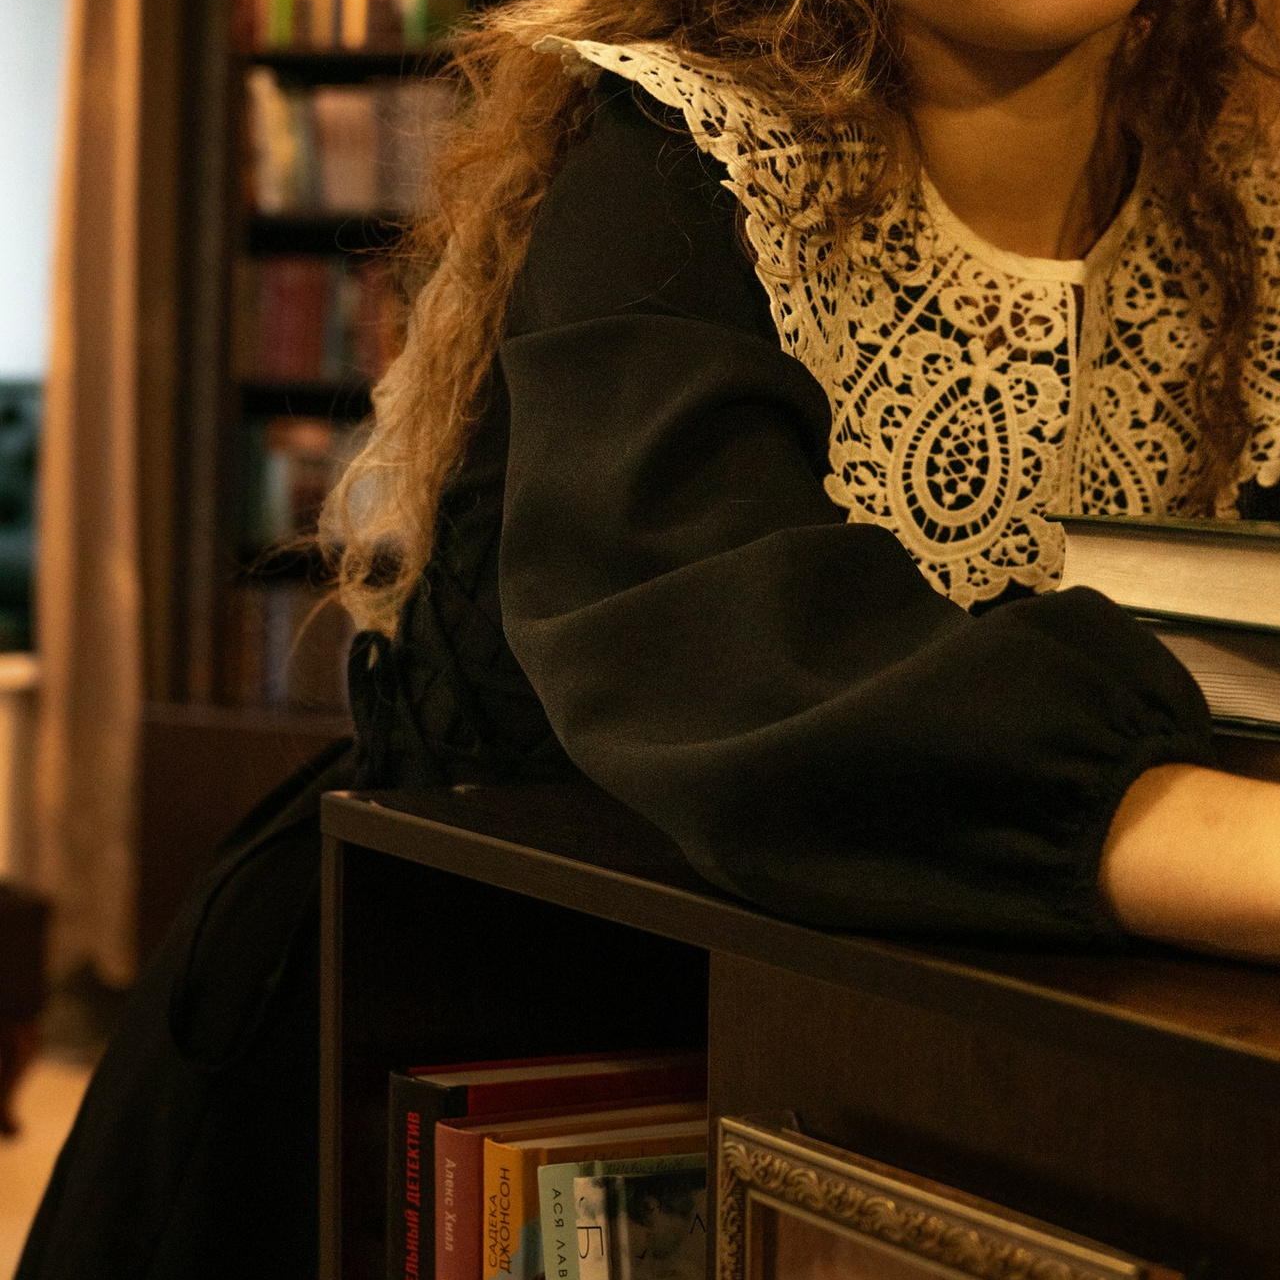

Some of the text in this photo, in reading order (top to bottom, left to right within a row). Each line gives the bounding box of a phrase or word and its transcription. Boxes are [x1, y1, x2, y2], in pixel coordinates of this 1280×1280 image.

[406, 1111, 420, 1206] ДЕТЕКТИВ
[444, 1157, 457, 1252] Алекс Хилл
[487, 1194, 498, 1268] САДЕКА
[499, 1167, 512, 1274] ДЖОНСОН
[552, 1187, 564, 1228] АСЯ
